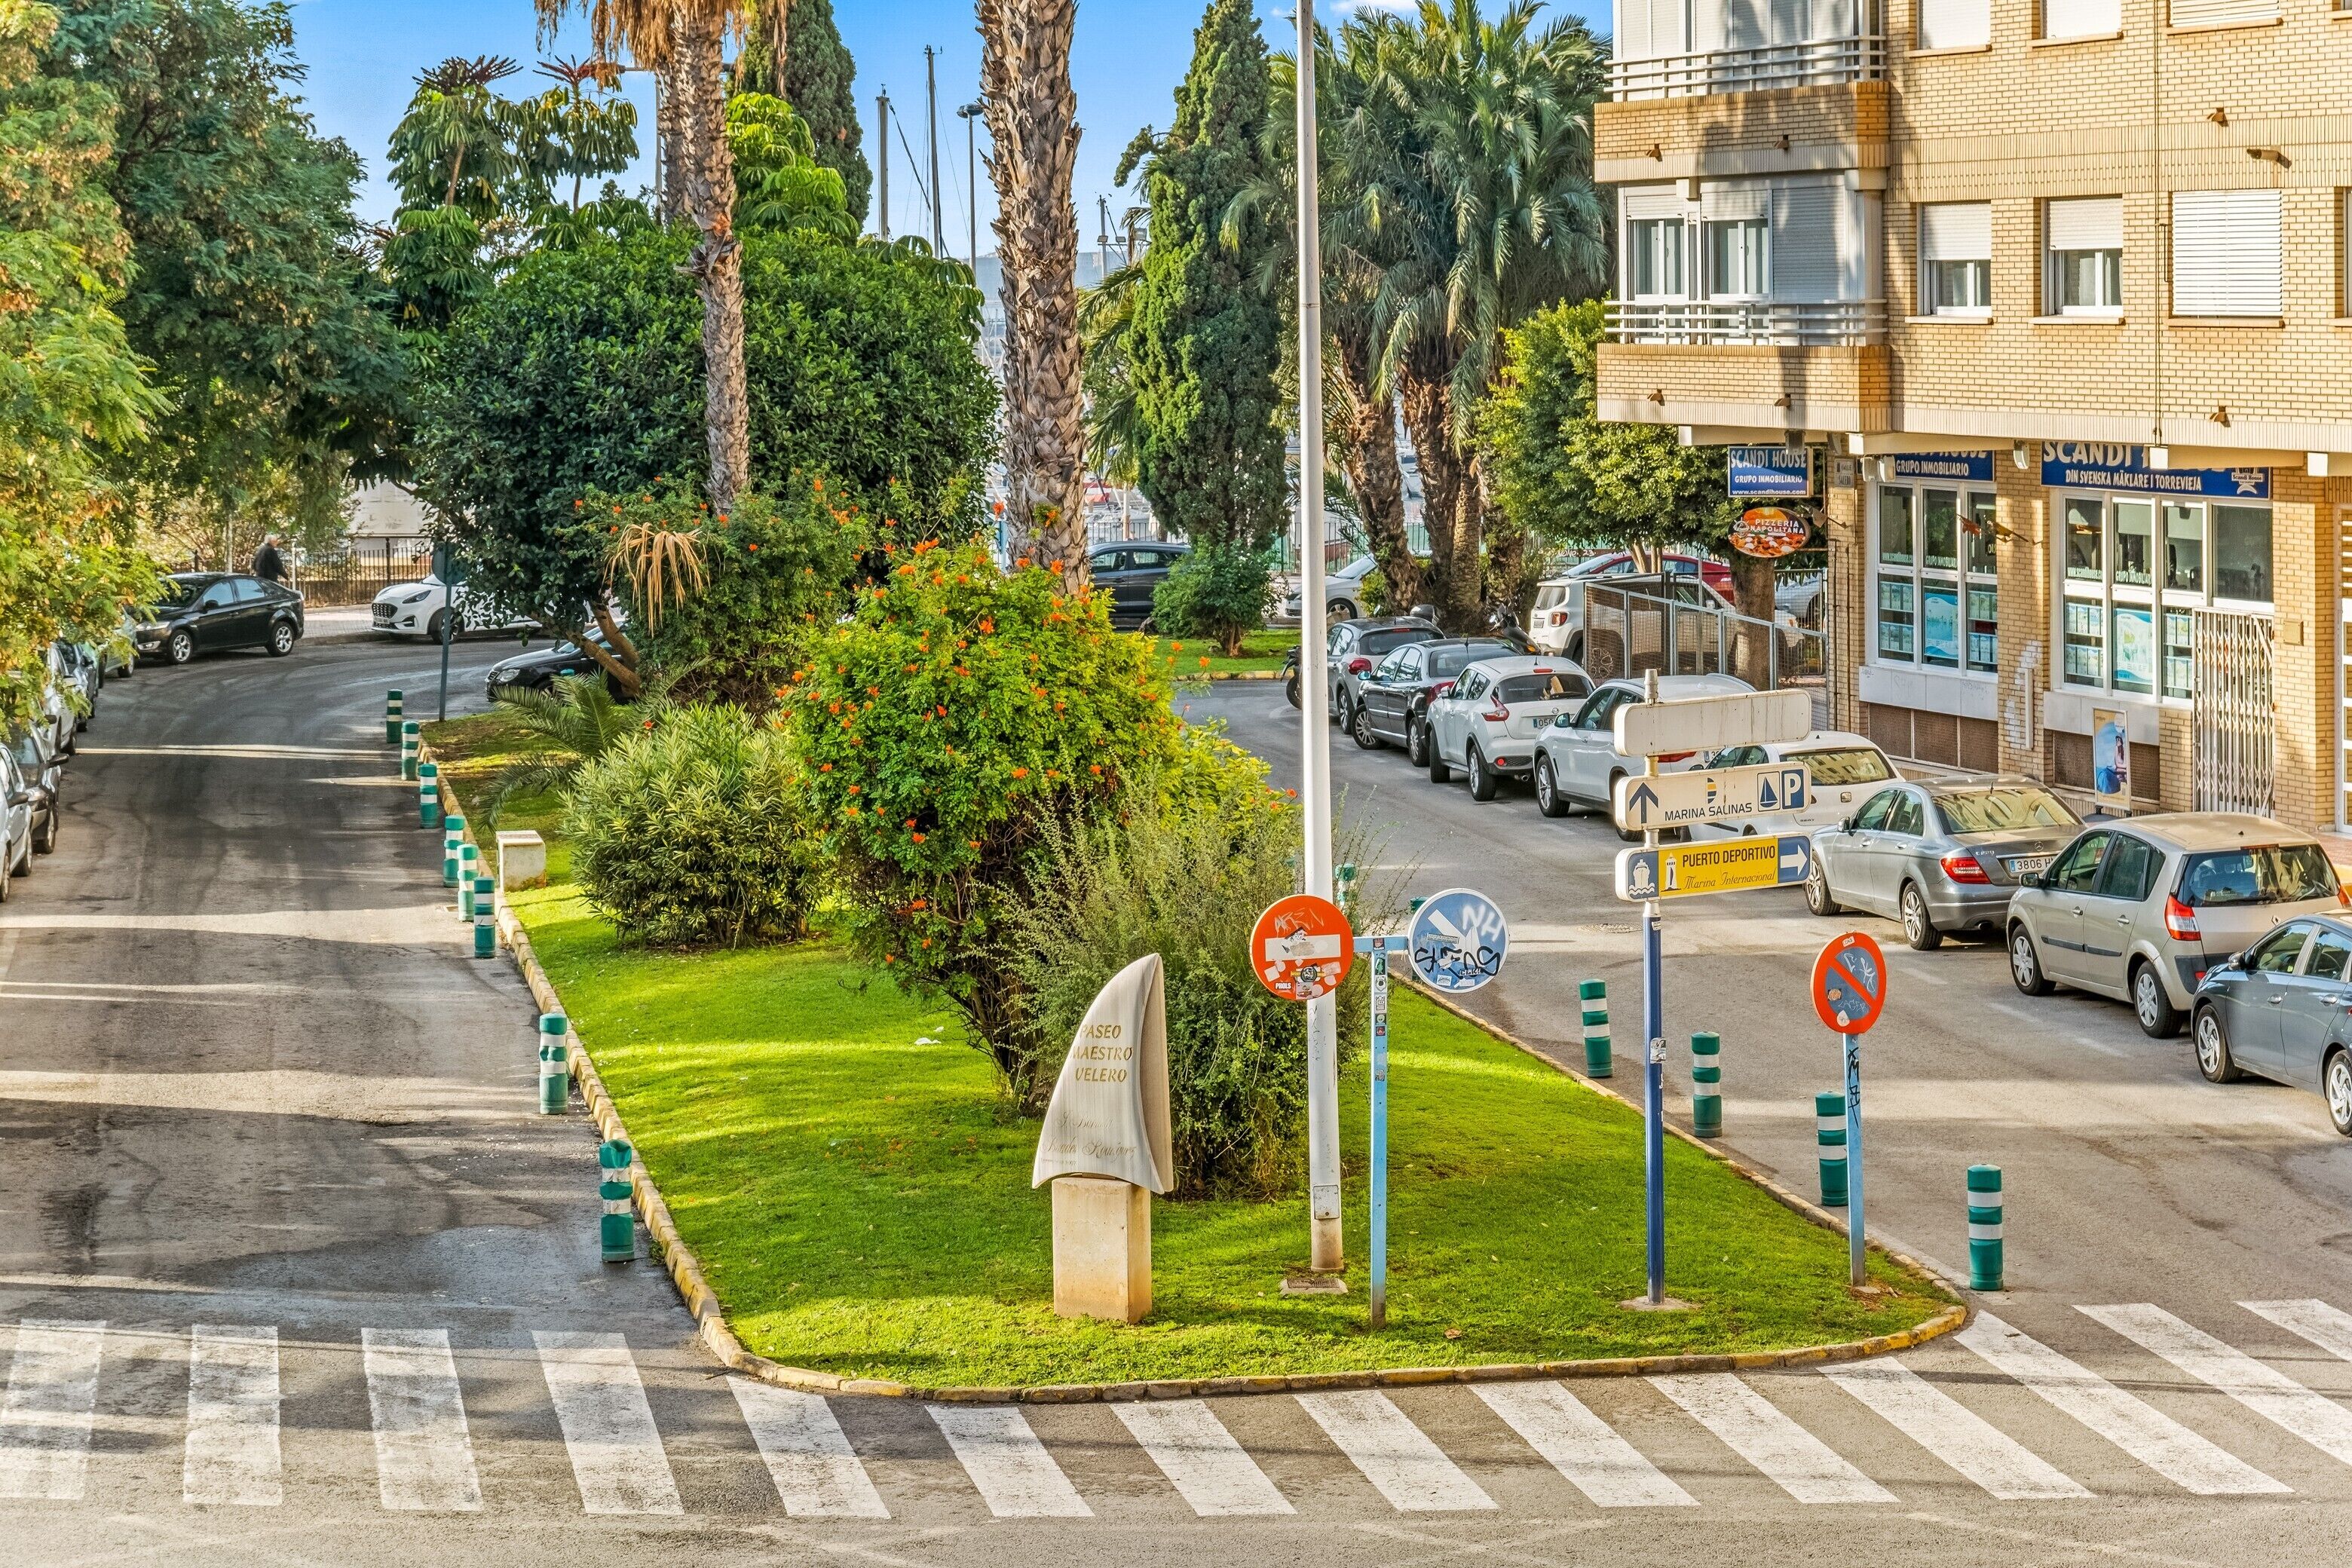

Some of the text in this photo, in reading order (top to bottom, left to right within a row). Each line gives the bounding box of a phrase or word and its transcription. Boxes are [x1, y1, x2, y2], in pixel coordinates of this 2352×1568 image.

[1730, 450, 1806, 468] SCANDI HOUSE
[2044, 442, 2131, 467] SCANDI
[1896, 460, 1969, 476] GRUPO INMOBILIARIO
[1759, 475, 1802, 483] INMOBILIARIO
[2066, 470, 2202, 491] DIN SVENSKA MÄKLARE I TORREVIEJA
[1750, 525, 1804, 534] NAPOLITANA
[1755, 519, 1799, 528] PIZZERIA
[1784, 773, 1801, 807] P
[1664, 802, 1752, 821] MARINA SALINAS
[1683, 845, 1775, 868] PUERTO DEPORTIVO
[2017, 859, 2042, 871] 3806
[1683, 868, 1777, 890] Marina Internacional
[1080, 1024, 1122, 1039] PASEO
[1075, 1067, 1128, 1083] VELERO
